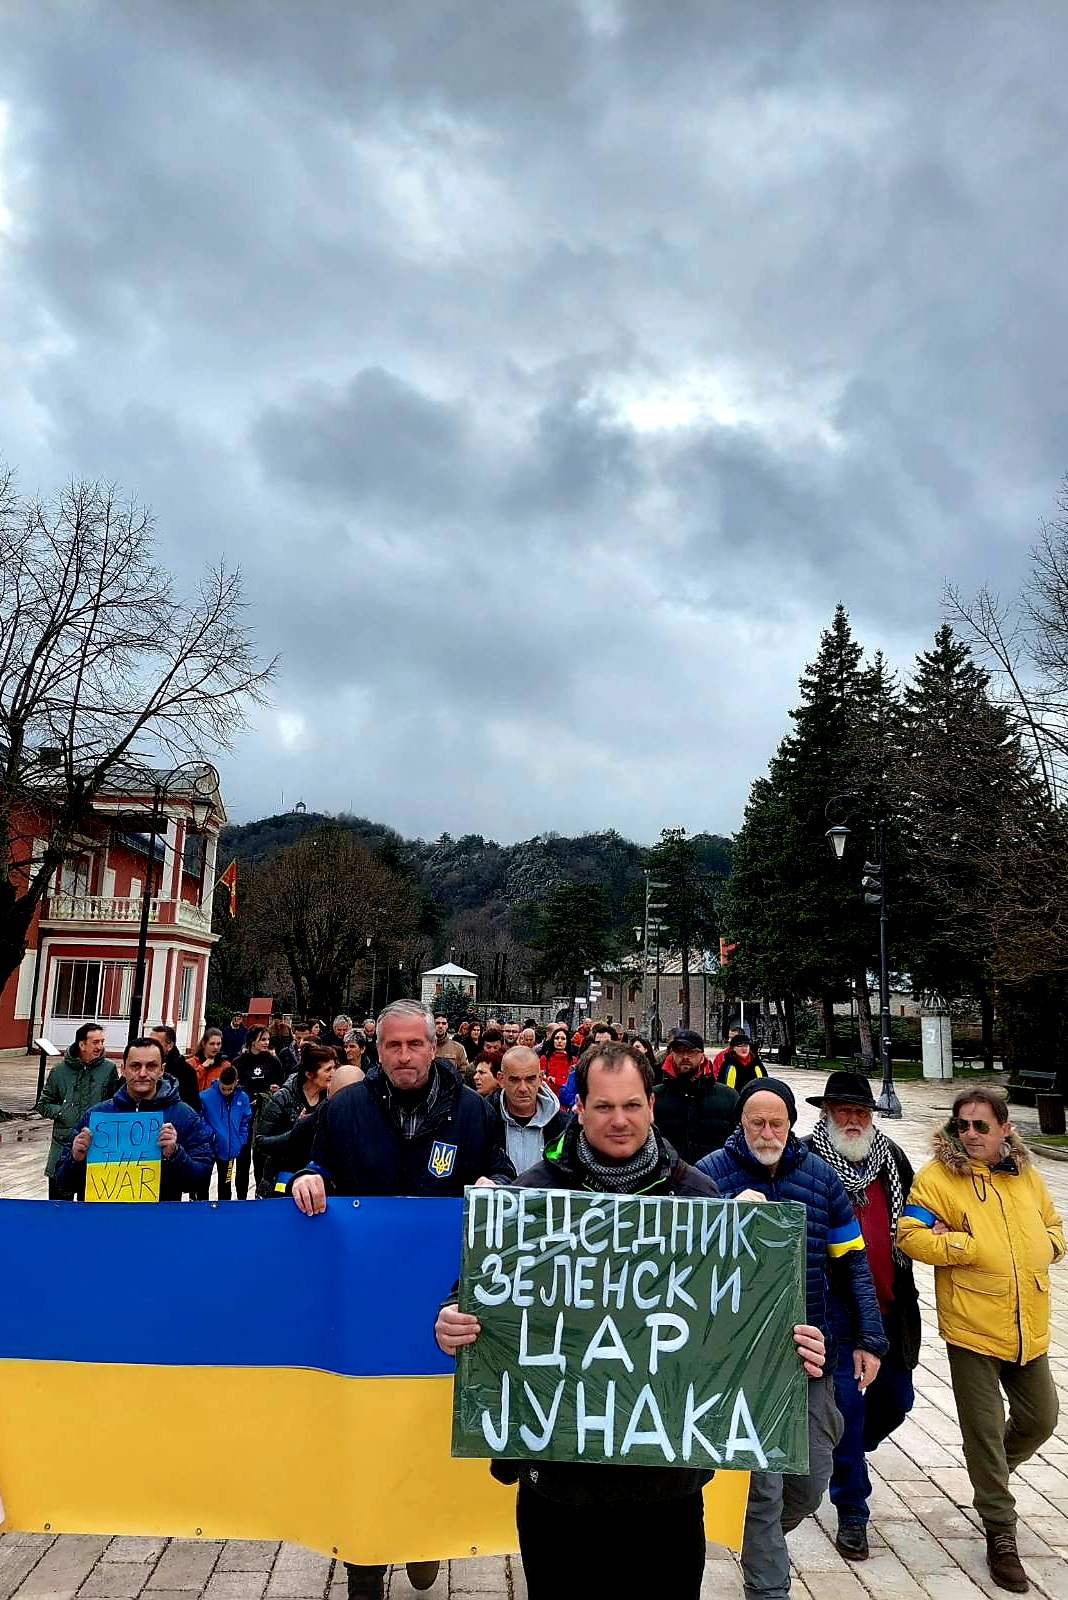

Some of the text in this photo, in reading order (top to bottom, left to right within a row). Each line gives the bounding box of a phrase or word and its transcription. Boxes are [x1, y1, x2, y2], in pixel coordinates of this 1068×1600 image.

[93, 1118, 160, 1149] STOP
[90, 1167, 157, 1200] WAR
[101, 1151, 150, 1169] THE
[473, 1253, 742, 1316] ЗЕЛЕНСКИ
[518, 1308, 690, 1376] ЦАР
[481, 1369, 769, 1469] ЈУНАКА
